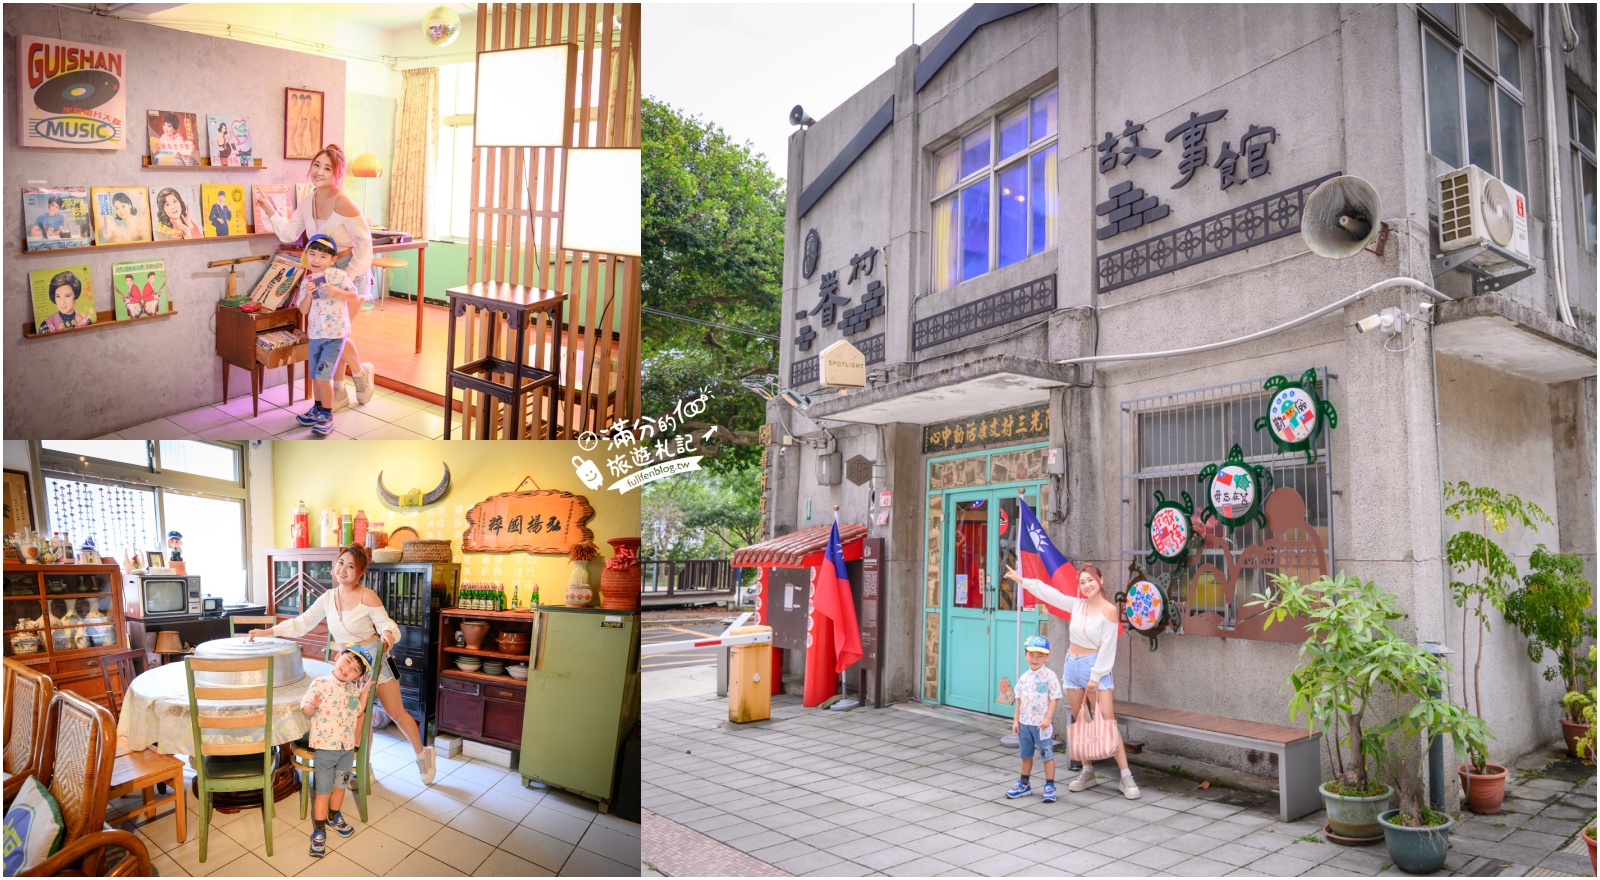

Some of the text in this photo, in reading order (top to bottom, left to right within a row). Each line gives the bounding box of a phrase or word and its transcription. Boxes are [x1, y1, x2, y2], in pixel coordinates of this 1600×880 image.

[28, 42, 122, 89] GUISHAN
[45, 120, 107, 139] MUSIC
[1097, 108, 1277, 191] 故事館
[808, 246, 878, 328] 眷村
[828, 360, 864, 369] SPOTLIGHT
